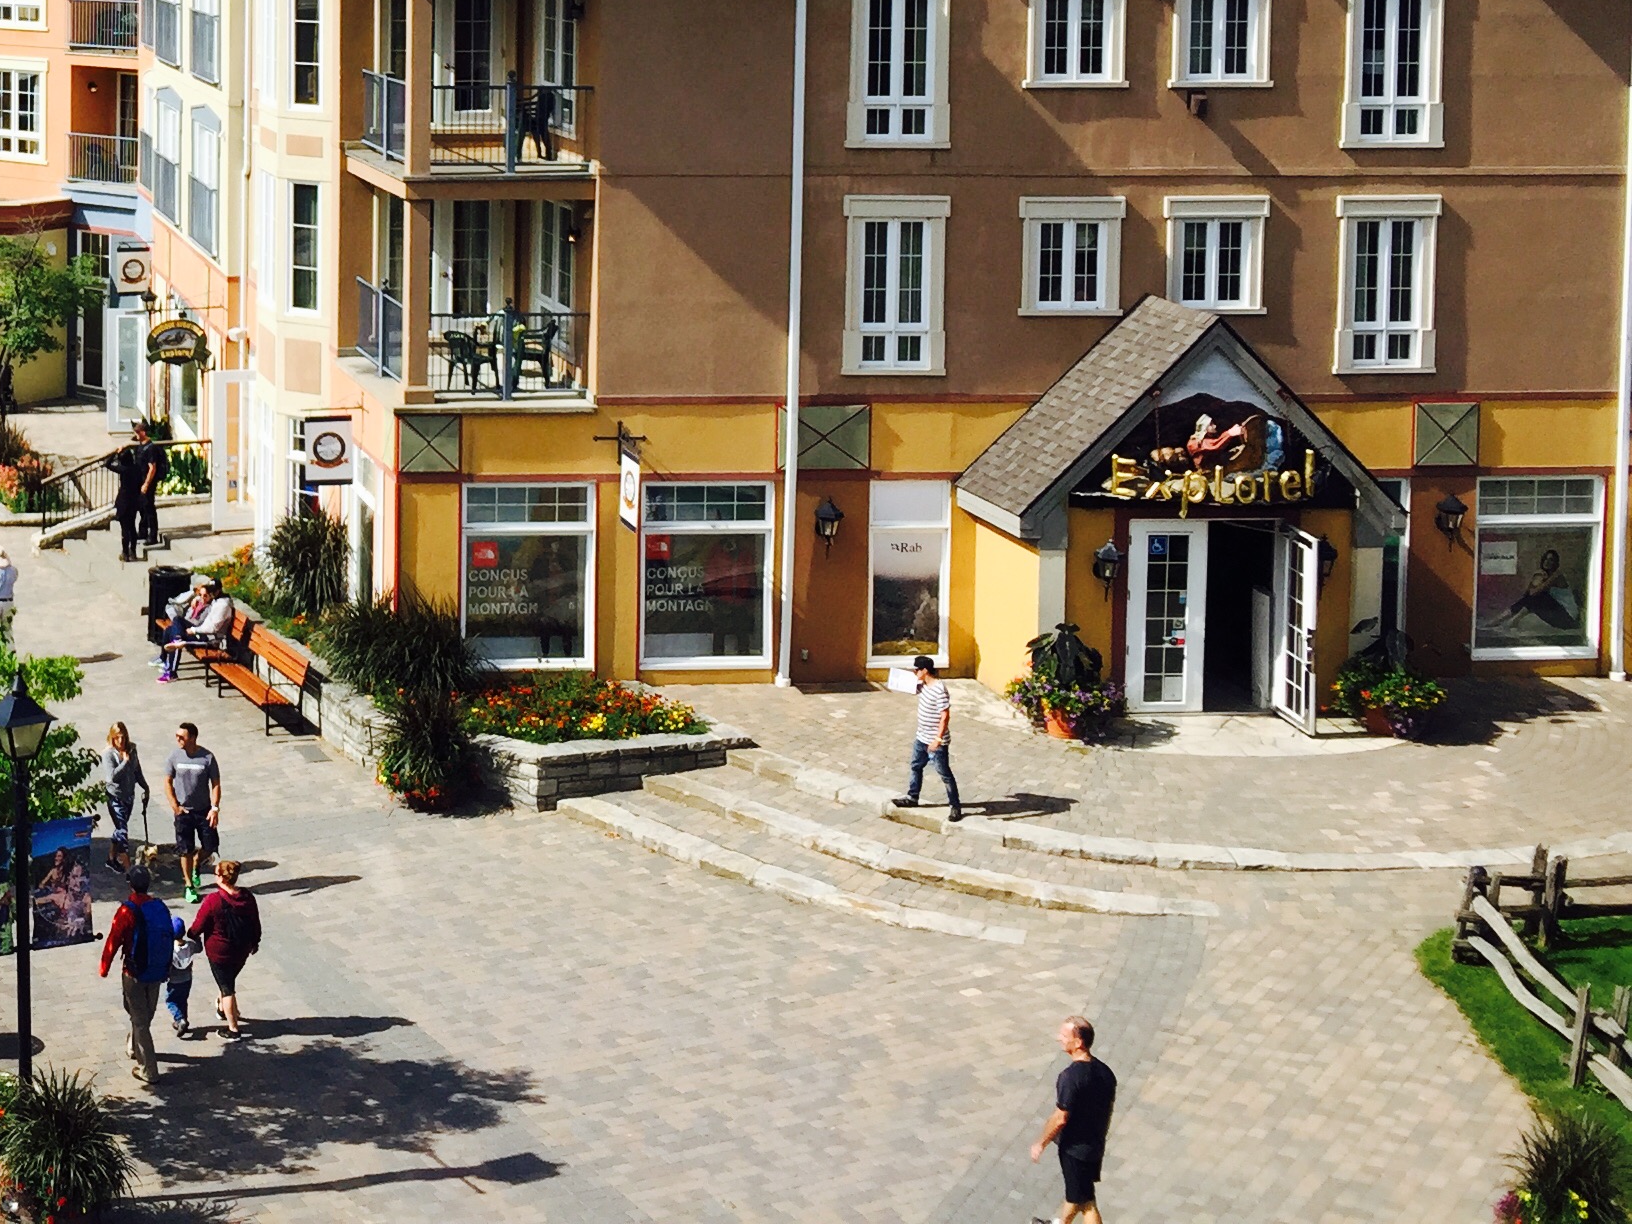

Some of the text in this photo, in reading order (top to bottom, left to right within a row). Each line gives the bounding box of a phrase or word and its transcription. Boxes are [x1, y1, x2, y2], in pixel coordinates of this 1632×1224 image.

[900, 542, 923, 553] Rab
[468, 569, 528, 584] CONÇUS
[646, 566, 705, 582] CONÇUS
[468, 585, 529, 598] POUR LA
[646, 582, 705, 596] POUR LA
